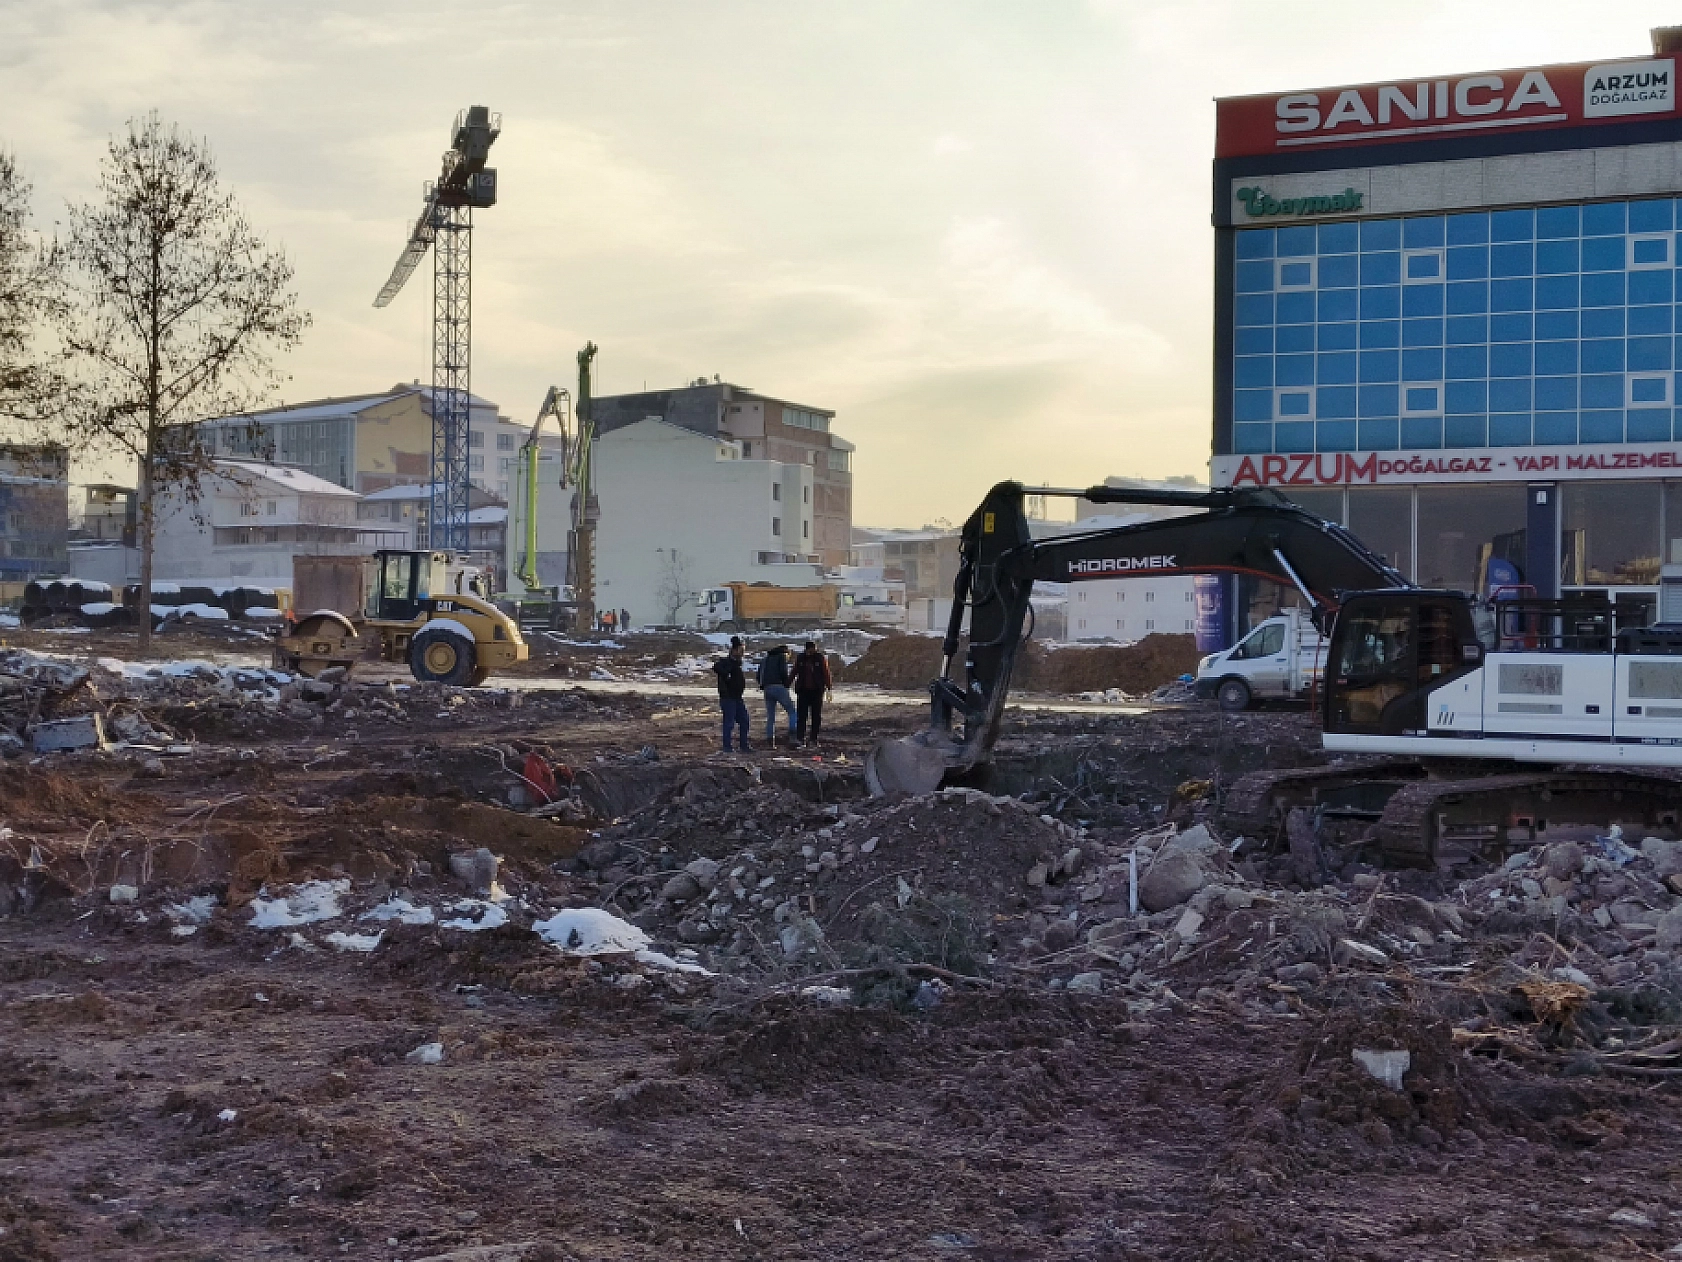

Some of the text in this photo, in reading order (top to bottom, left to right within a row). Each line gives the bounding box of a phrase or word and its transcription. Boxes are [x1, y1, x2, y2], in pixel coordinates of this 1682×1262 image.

[1591, 72, 1668, 92] ARZUM
[1275, 71, 1561, 133] SANICA
[1590, 89, 1667, 106] DOĞALGAZ
[1232, 452, 1377, 486] ARZUM
[1378, 455, 1492, 475] DOĞALGAZ
[1513, 455, 1560, 472] YAPI
